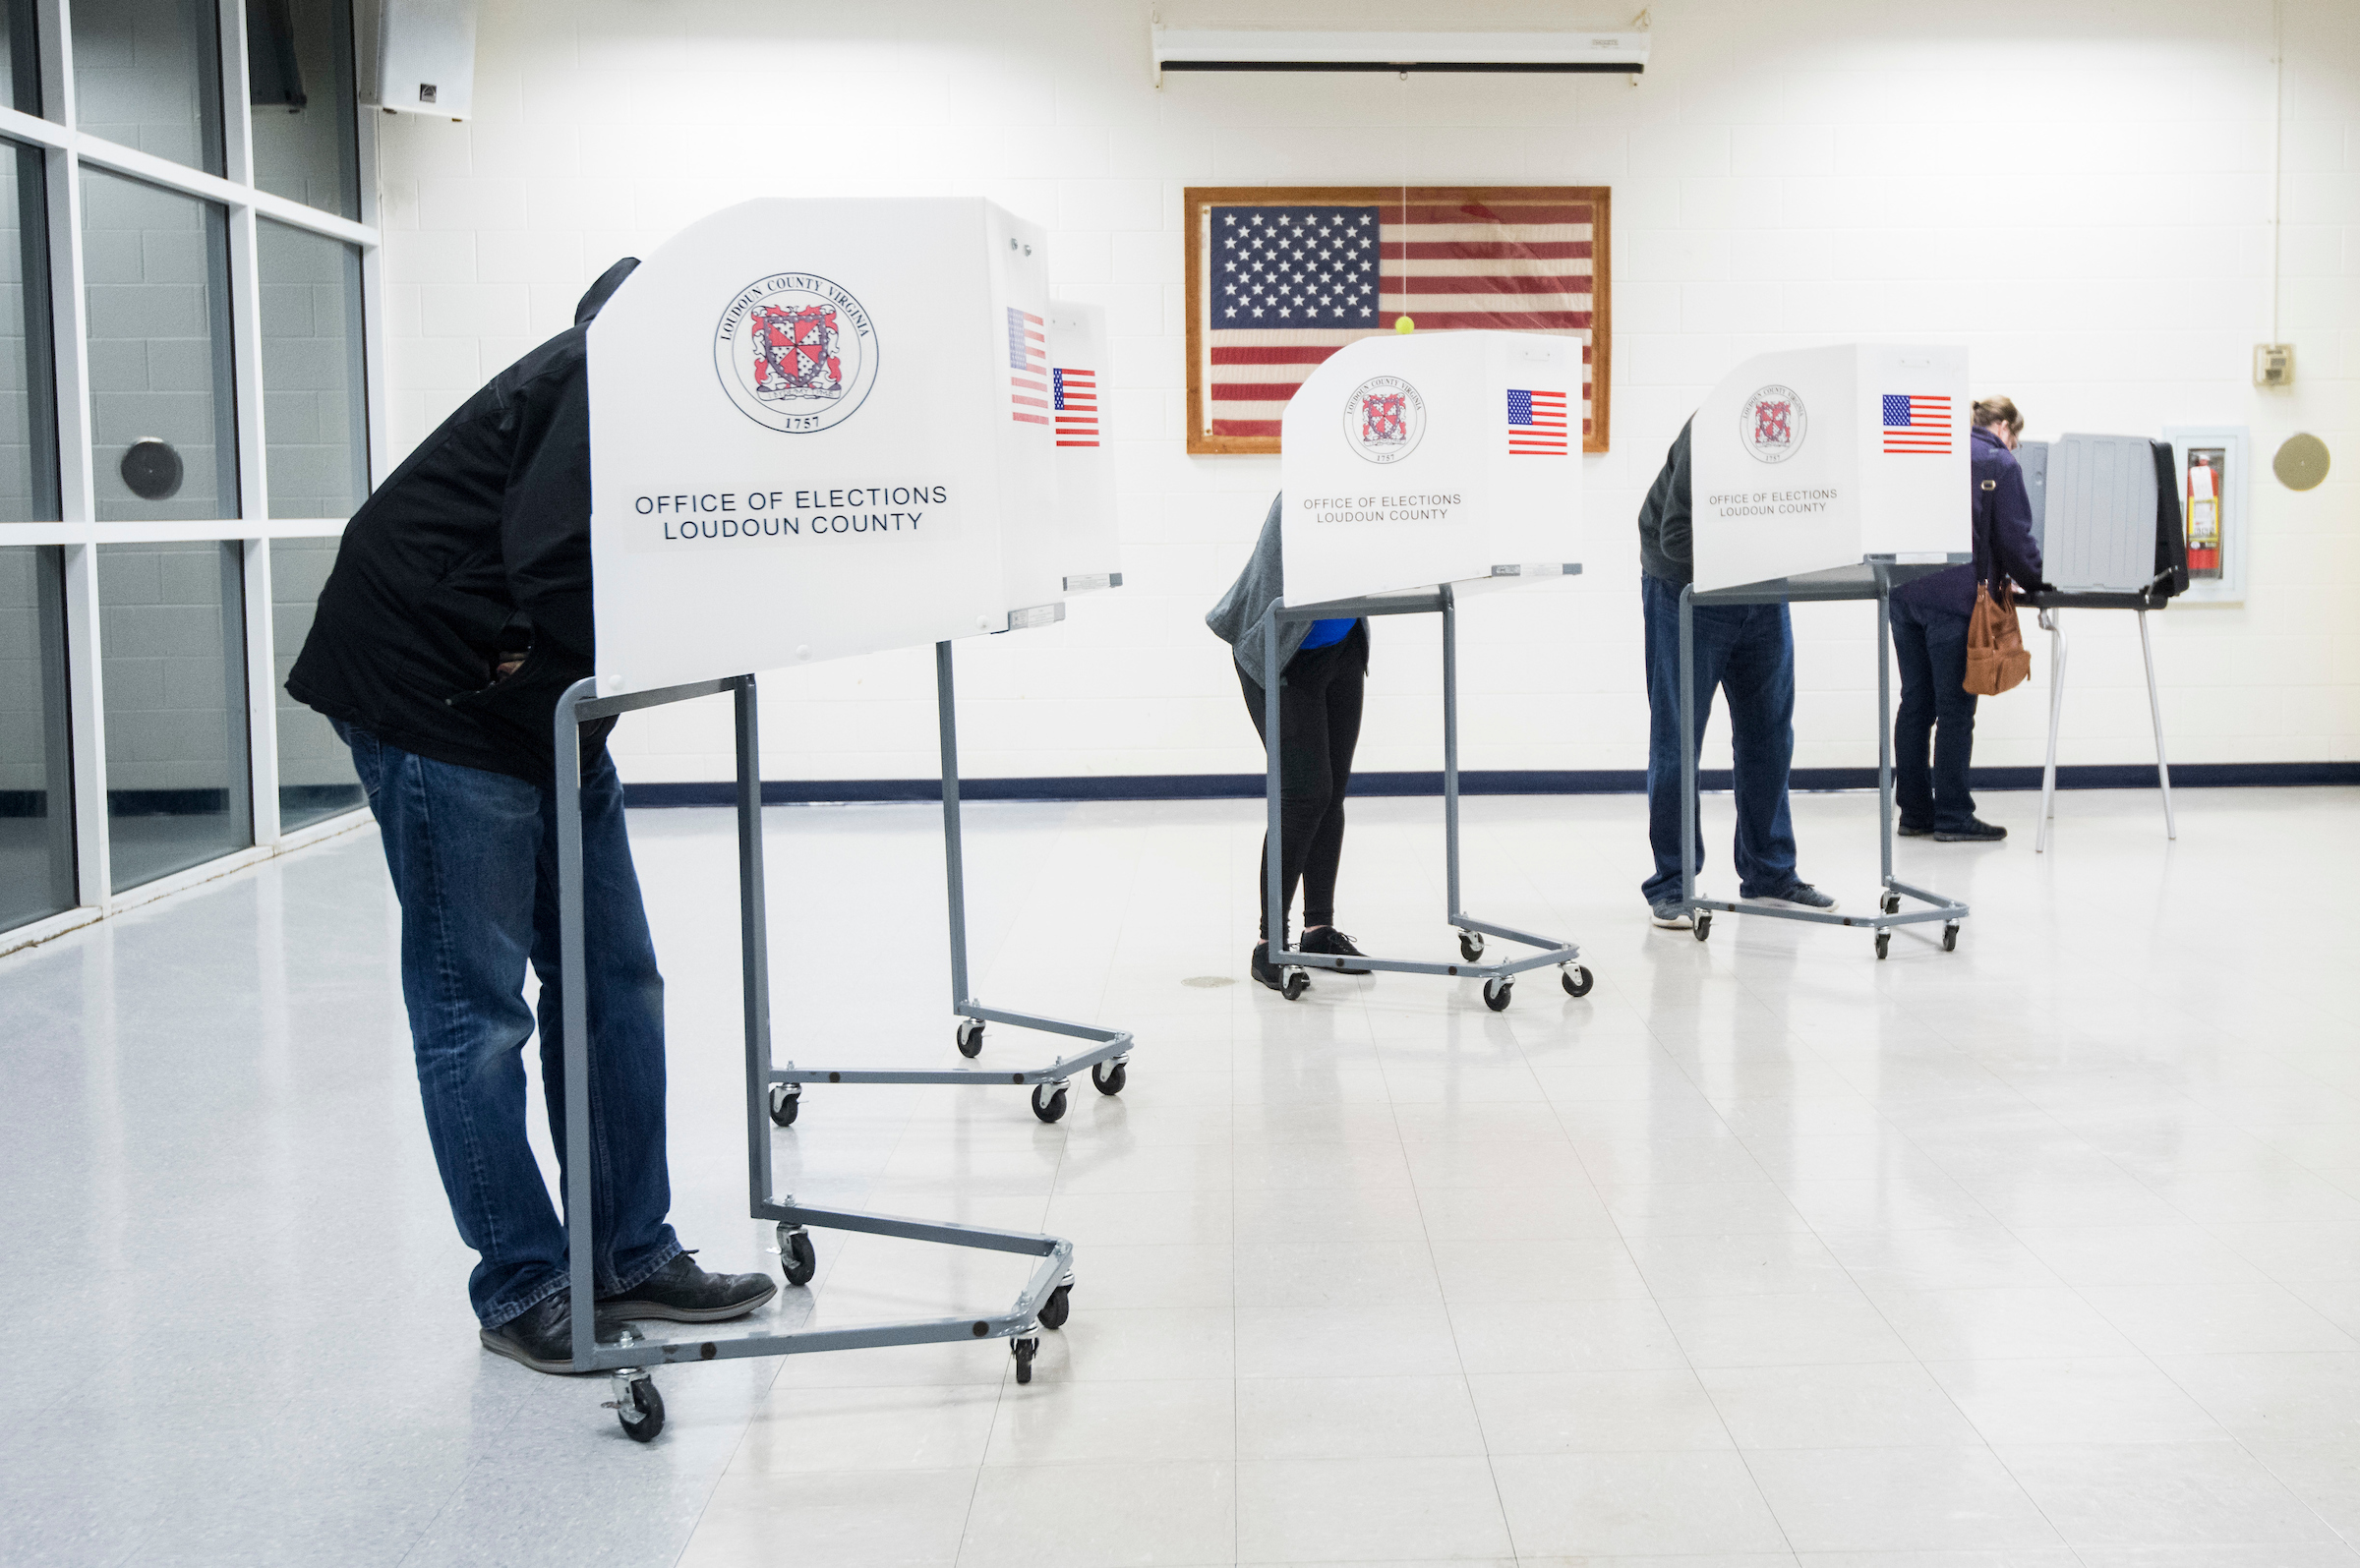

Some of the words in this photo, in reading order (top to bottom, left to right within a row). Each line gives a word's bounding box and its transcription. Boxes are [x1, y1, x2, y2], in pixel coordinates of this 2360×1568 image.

[720, 286, 763, 341] LOUDOUN
[767, 276, 824, 292] COUNTY
[828, 286, 871, 337] VIRGINIA
[1371, 377, 1400, 387] COUNTY
[1401, 382, 1422, 411] VIRGINIA
[785, 416, 820, 430] 1757
[1377, 453, 1395, 462] 1757
[635, 494, 738, 515] OFFICE
[747, 491, 784, 510] OF
[796, 485, 948, 509] ELECTIONS
[1303, 497, 1353, 509] OFFICE
[1358, 496, 1377, 508] OF
[1382, 494, 1462, 507] ELECTIONS
[1709, 494, 1749, 505] OFFICE
[1752, 493, 1768, 503] OF
[1772, 489, 1838, 502] ELECTIONS
[1317, 510, 1385, 523] LOUDOUN
[1389, 508, 1448, 521] COUNTY
[1720, 504, 1775, 517] LOUDOUN
[1778, 501, 1827, 514] COUNTY
[664, 516, 799, 541] LOUDOUN
[811, 512, 923, 534] COUNTY
